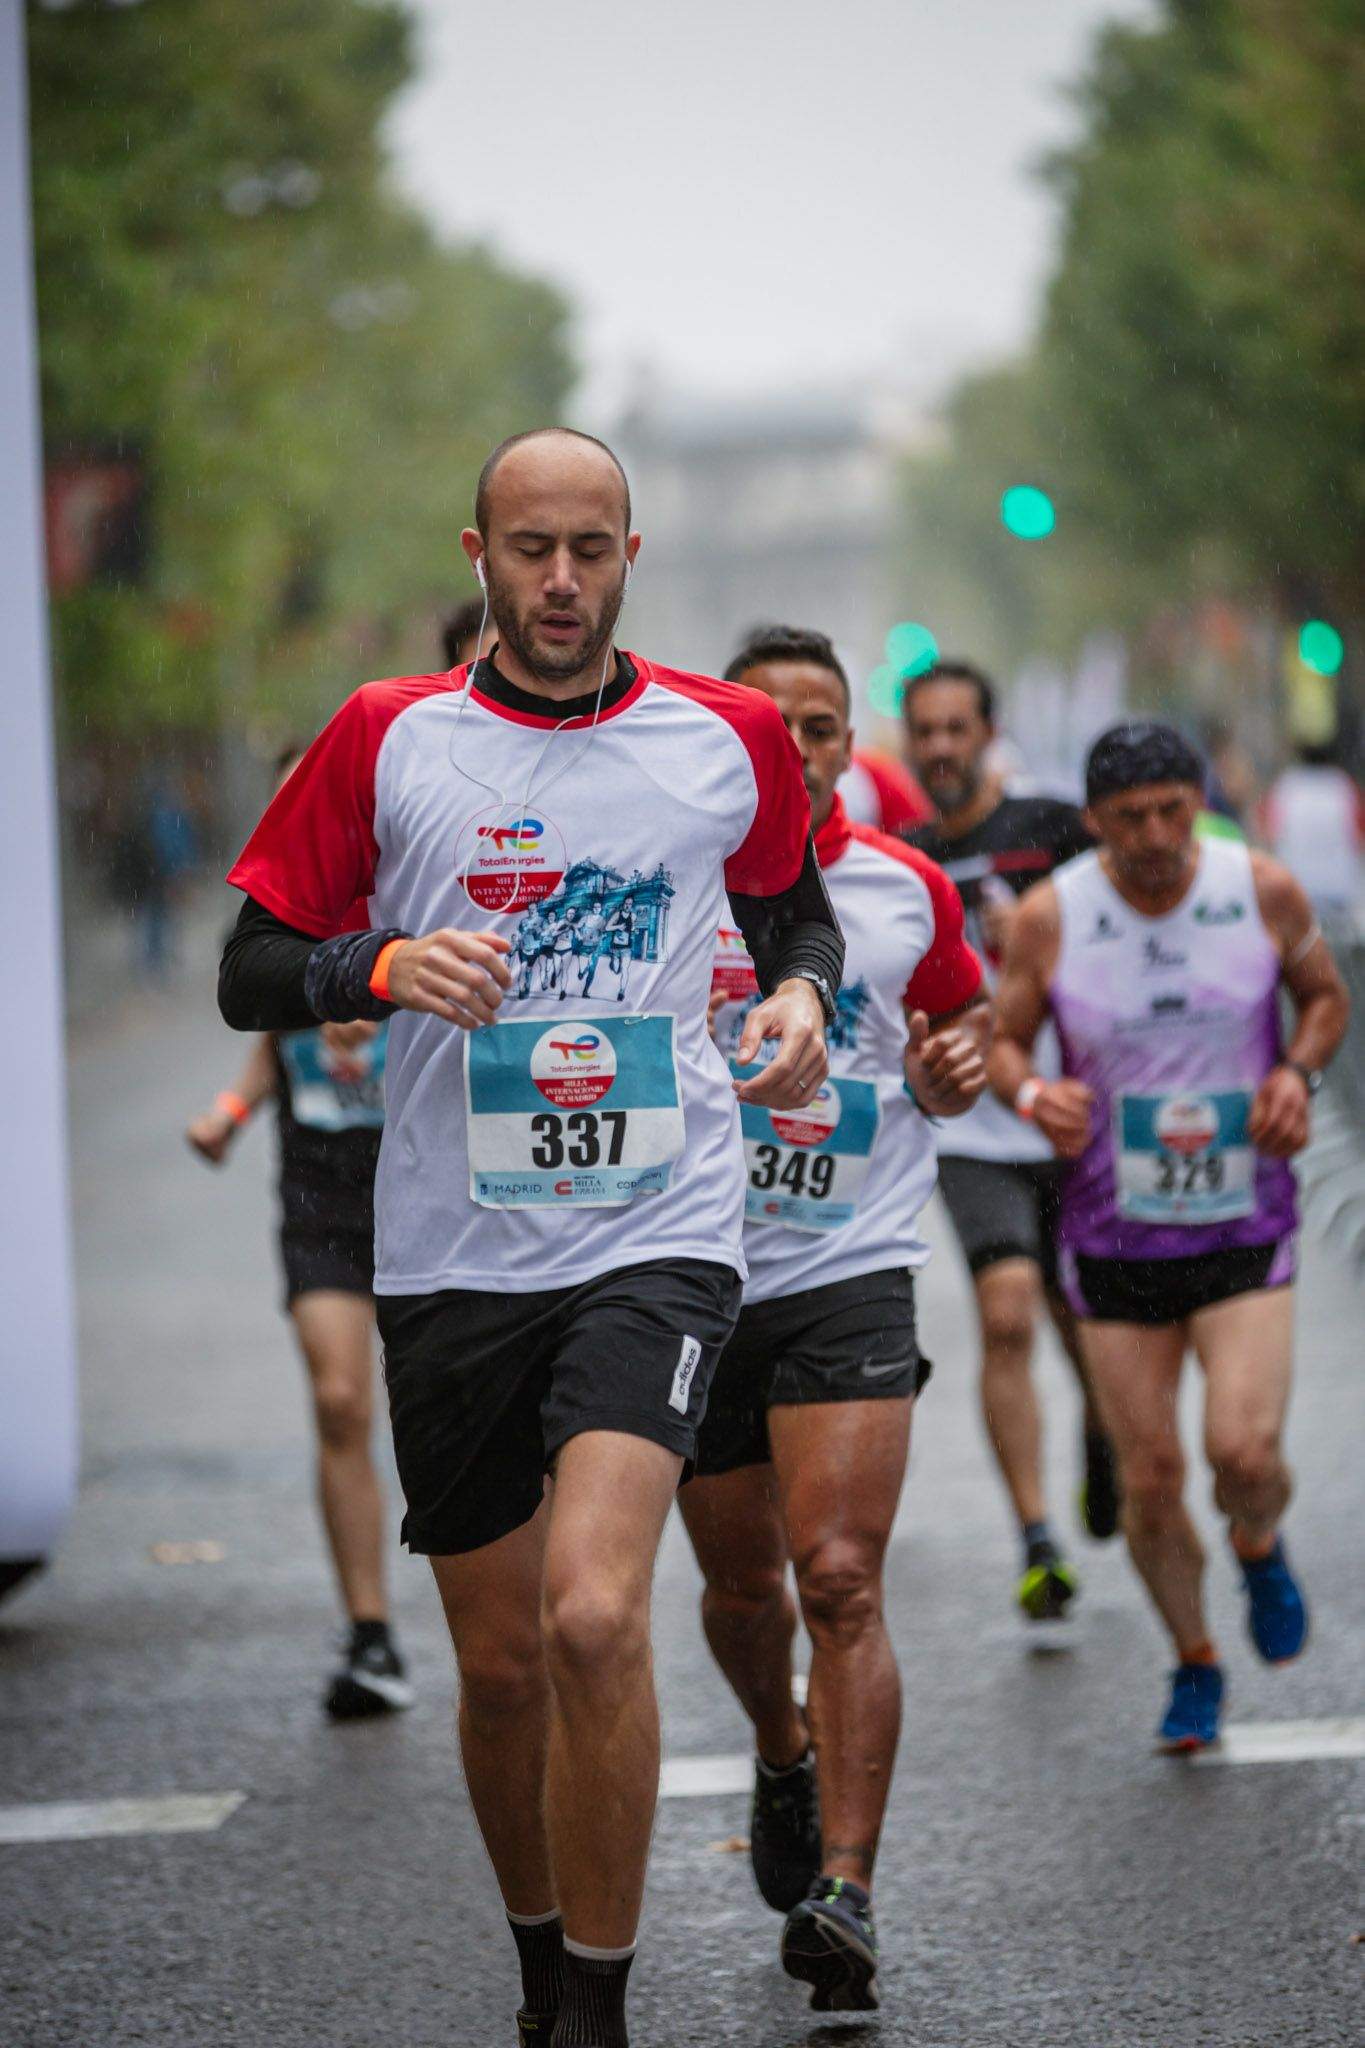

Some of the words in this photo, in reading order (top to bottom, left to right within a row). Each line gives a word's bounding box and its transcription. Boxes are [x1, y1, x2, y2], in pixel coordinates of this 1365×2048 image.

[531, 1111, 627, 1169] 337
[494, 1184, 543, 1195] MADRID
[751, 1144, 836, 1200] 349
[679, 1348, 696, 1395] adidas
